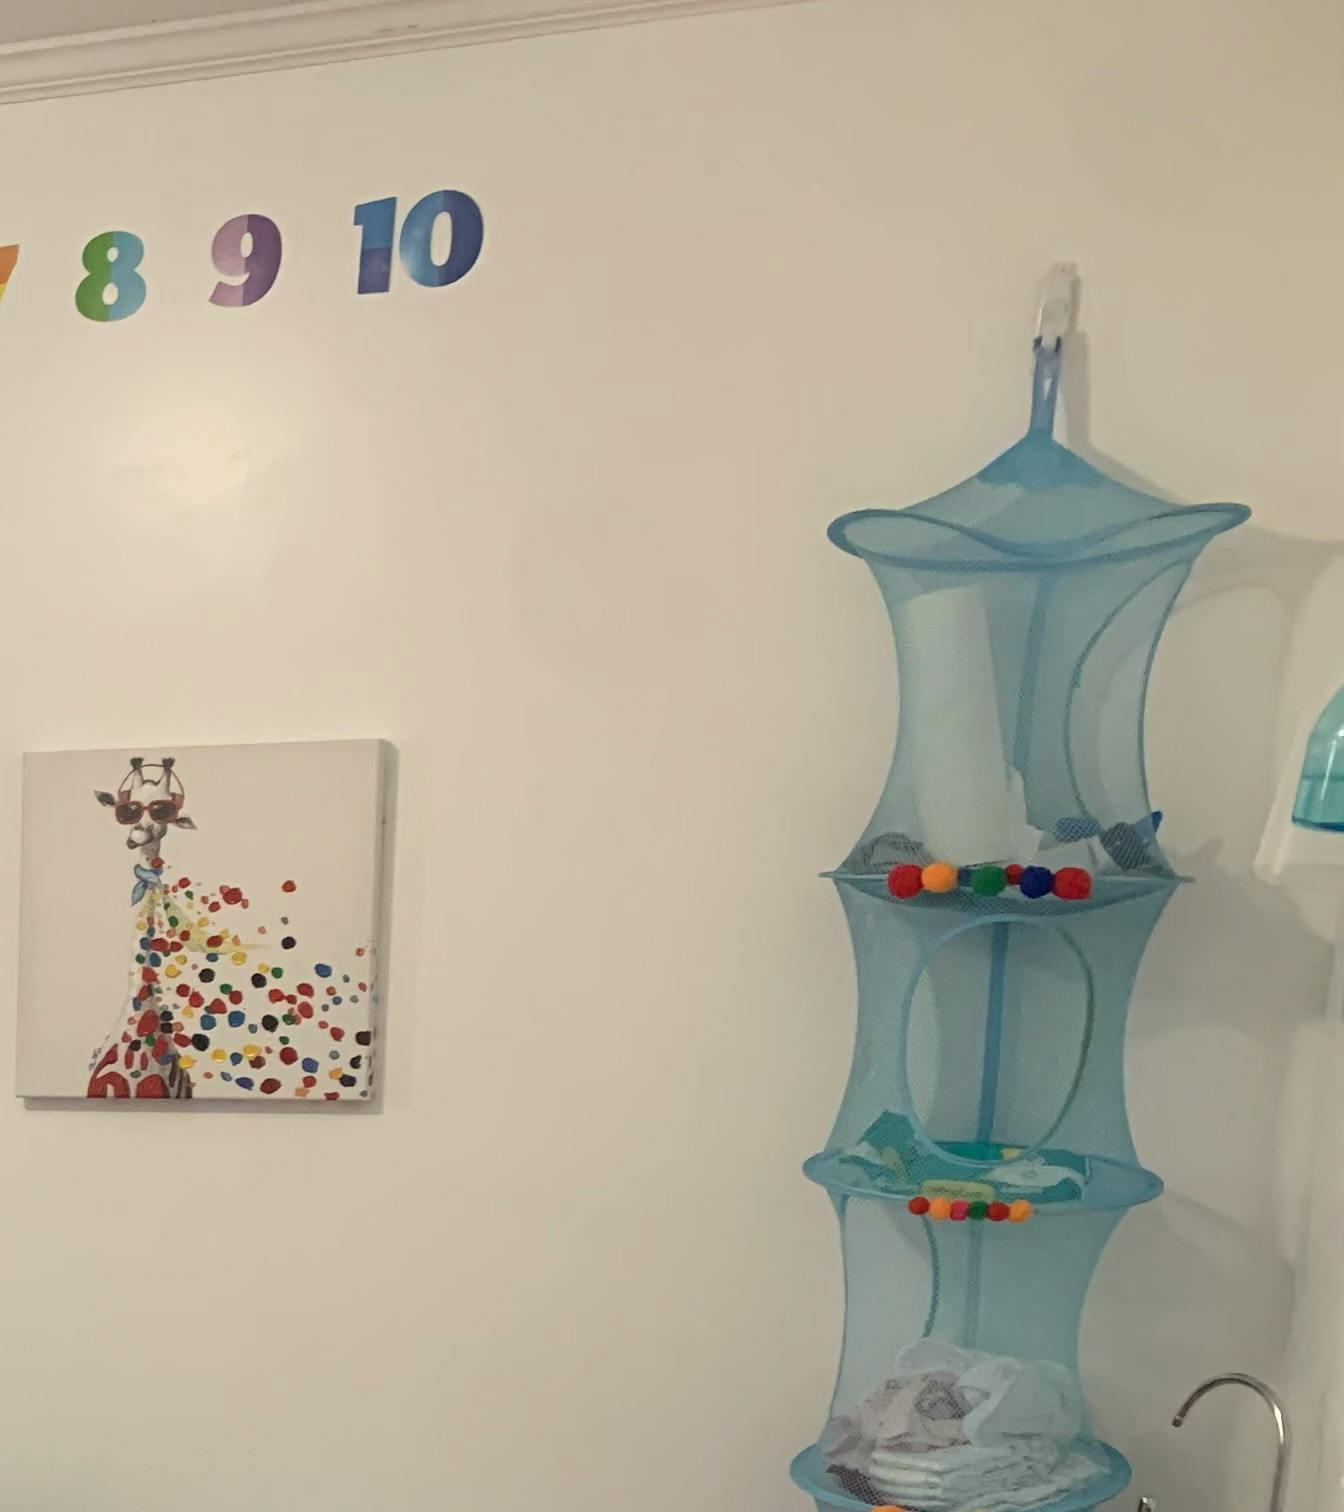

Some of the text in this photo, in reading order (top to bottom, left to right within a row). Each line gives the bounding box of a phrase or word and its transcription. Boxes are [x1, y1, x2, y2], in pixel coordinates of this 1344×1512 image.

[74, 230, 147, 322] 8
[208, 213, 283, 308] 9
[353, 189, 485, 295] 10
